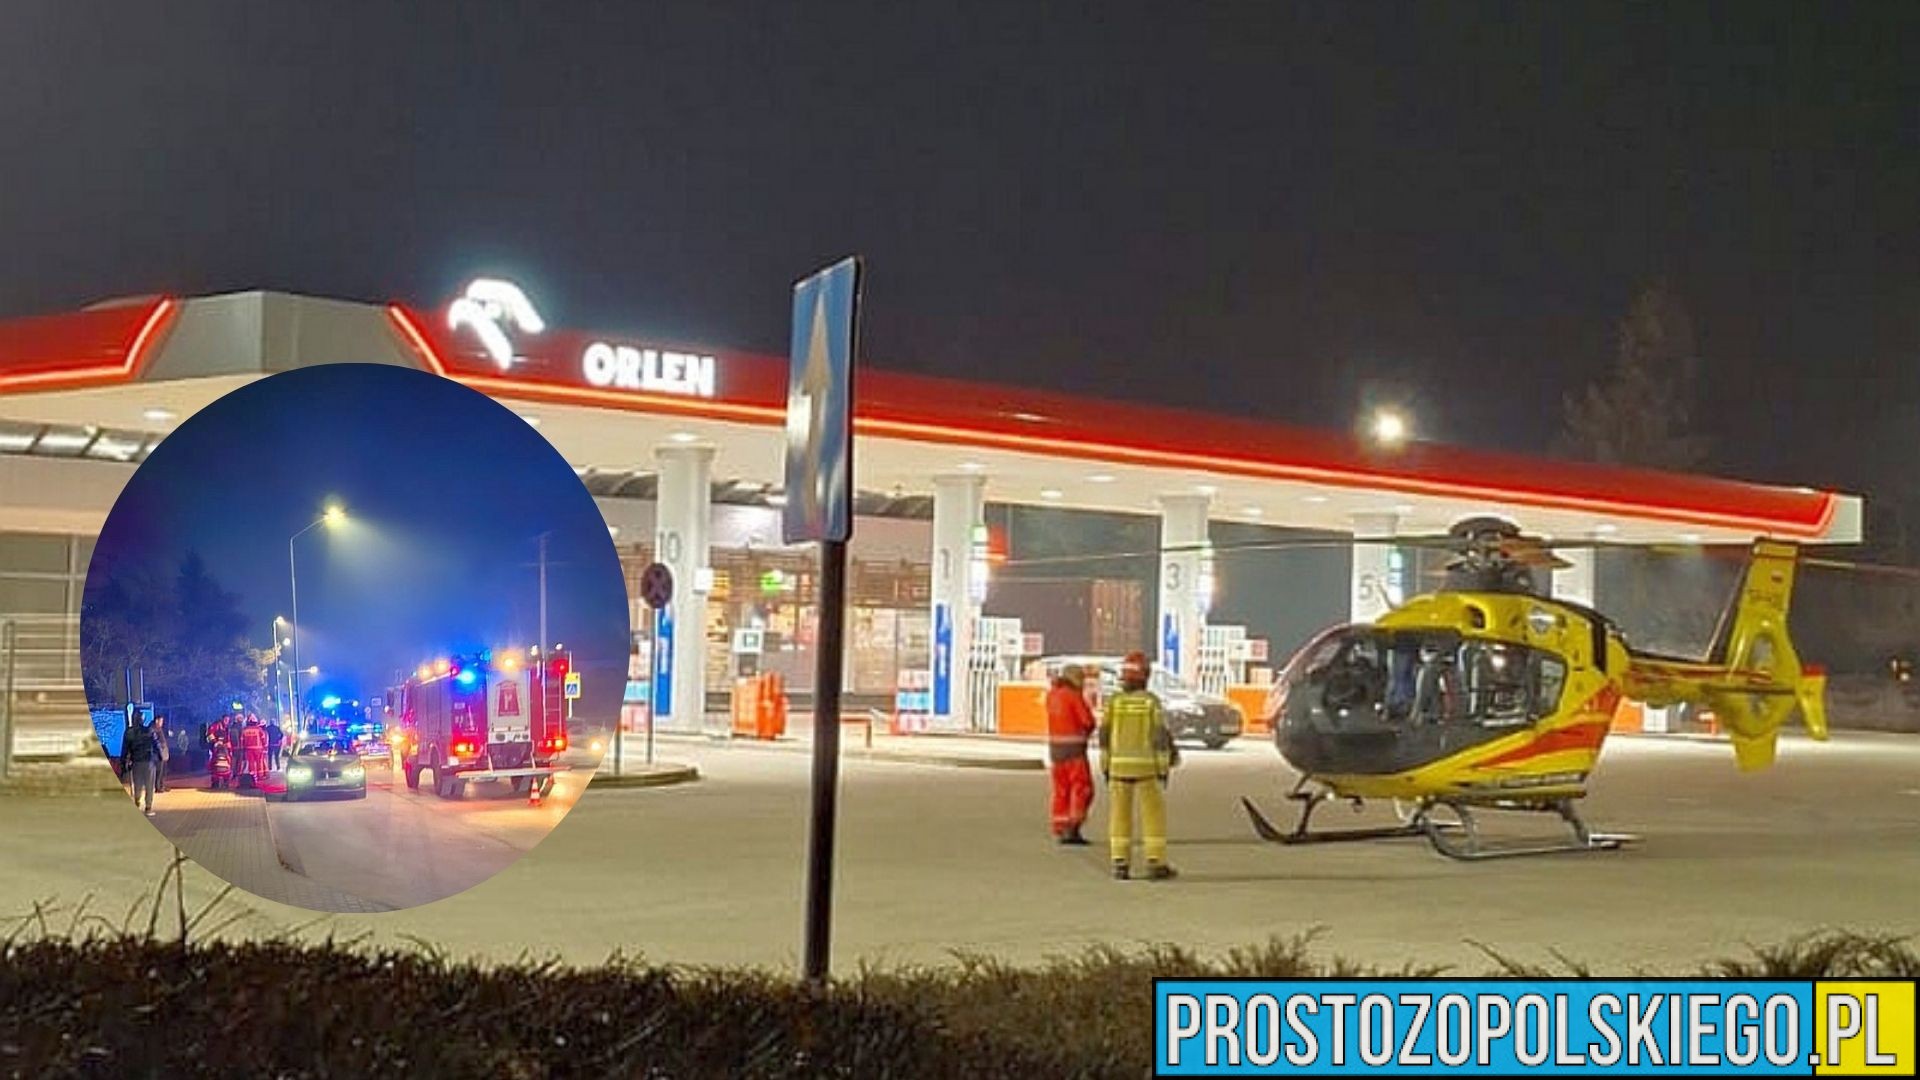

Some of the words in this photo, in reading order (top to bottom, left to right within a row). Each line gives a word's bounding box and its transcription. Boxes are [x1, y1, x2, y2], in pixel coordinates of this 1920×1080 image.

[583, 342, 715, 396] ORLEN
[1166, 563, 1180, 590] 3
[1360, 574, 1374, 600] 5
